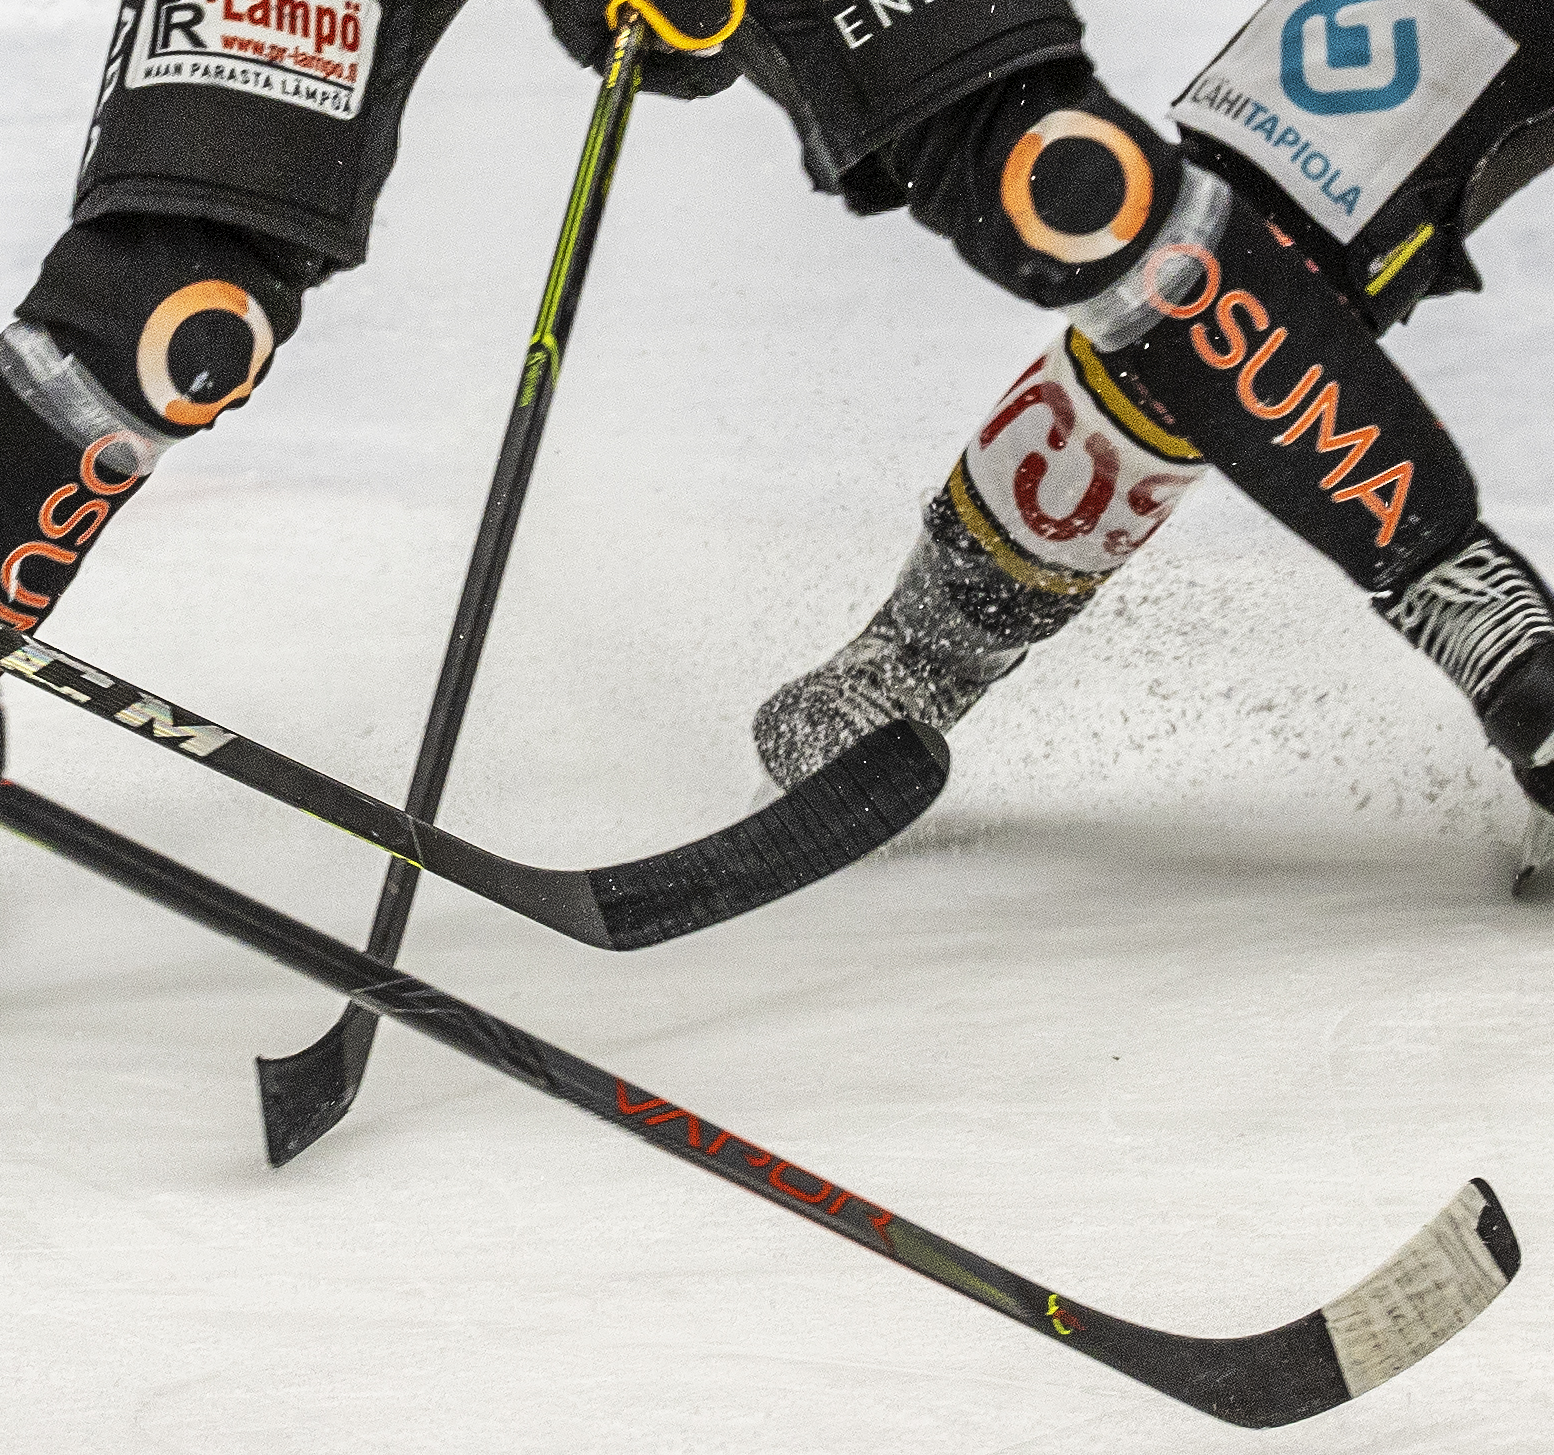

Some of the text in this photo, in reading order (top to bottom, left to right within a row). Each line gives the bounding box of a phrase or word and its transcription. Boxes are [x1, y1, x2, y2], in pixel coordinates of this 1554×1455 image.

[190, 62, 275, 90] PARASTA
[1146, 244, 1415, 547] OSUMA
[614, 1076, 895, 1254] VAPOR
